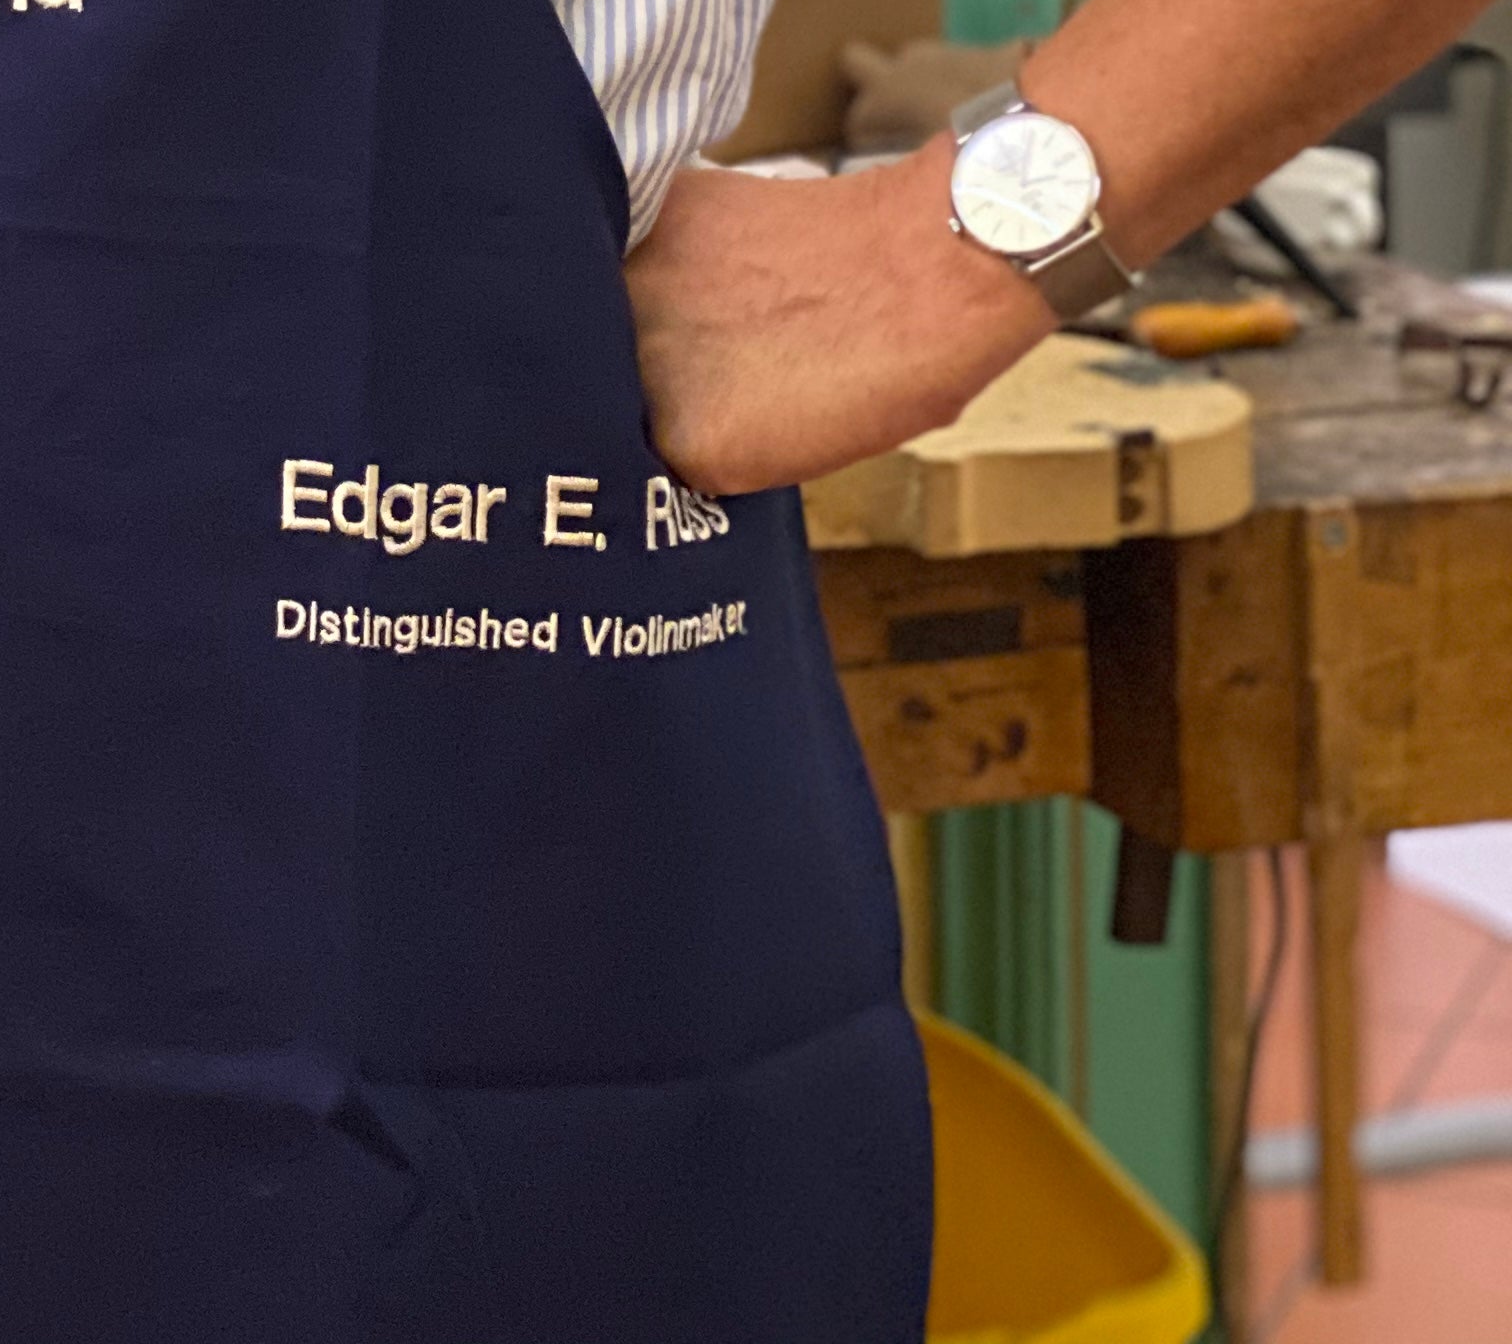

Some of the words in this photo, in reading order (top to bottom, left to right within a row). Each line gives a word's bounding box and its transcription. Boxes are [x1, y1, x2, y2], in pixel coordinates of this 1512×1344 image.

[281, 459, 507, 555] Edgar
[543, 475, 607, 552] E.
[277, 599, 558, 654] Distinguished
[582, 600, 748, 658] Violinmaker
